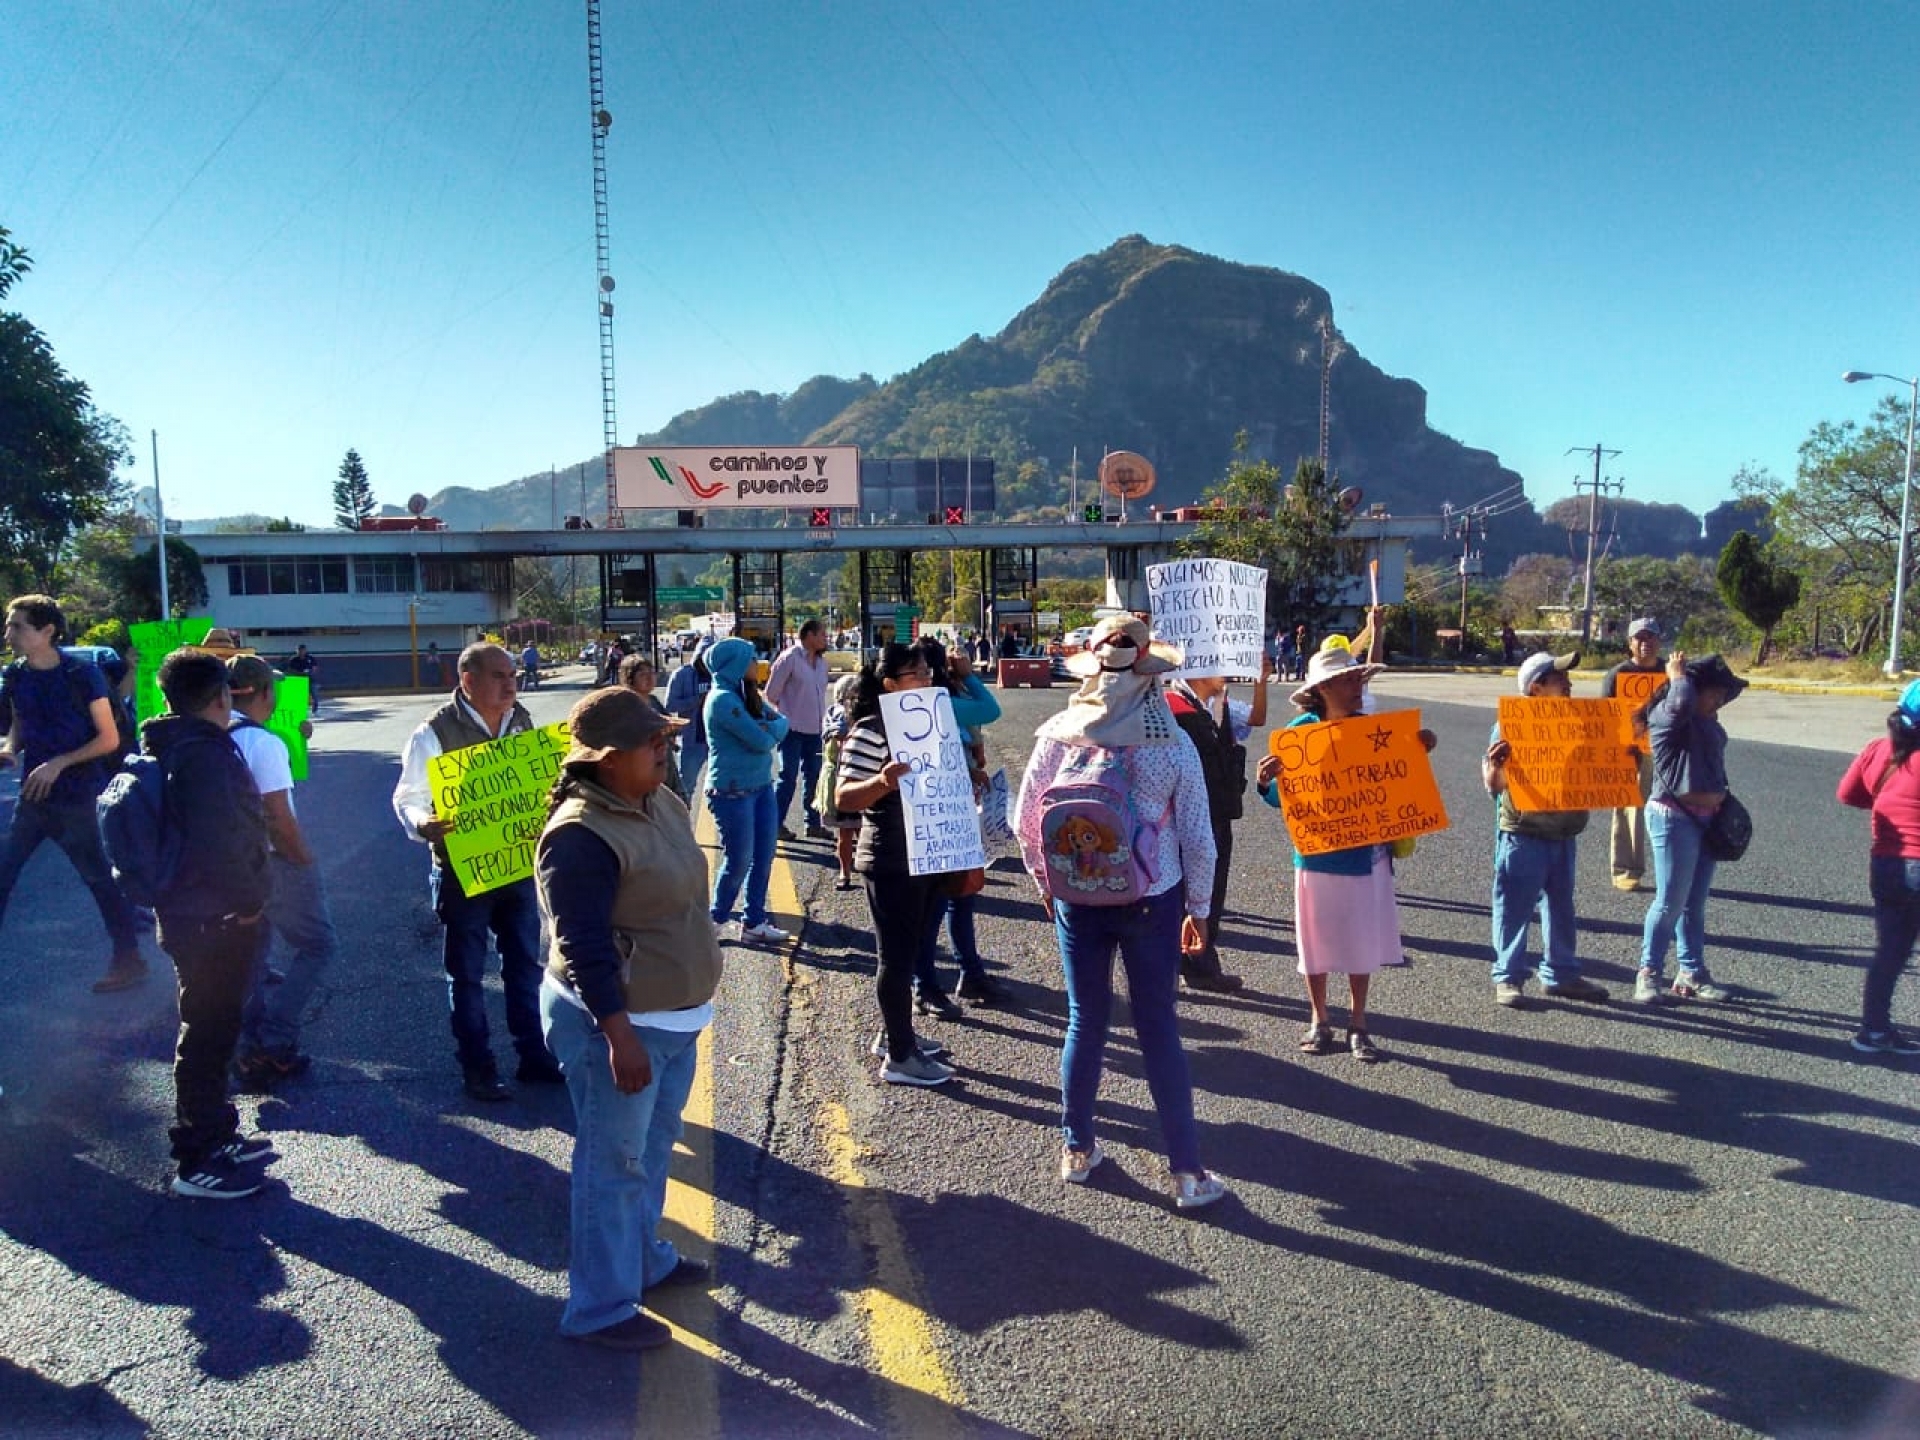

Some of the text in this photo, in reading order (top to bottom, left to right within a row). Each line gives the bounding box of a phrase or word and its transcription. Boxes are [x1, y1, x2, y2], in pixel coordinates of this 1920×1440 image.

[709, 452, 807, 472] caminos
[737, 474, 829, 500] puentes
[1149, 561, 1224, 590] EXIGIMOS
[1152, 585, 1224, 616] DERECHO
[1230, 587, 1240, 610] A
[1501, 700, 1622, 720] LOS VECINOS DE LA
[1532, 723, 1550, 742] DEL
[1557, 721, 1605, 742] CARMEN
[436, 734, 530, 781] EXIGIMOS
[536, 729, 552, 750] A
[1277, 721, 1345, 772] SCT
[1573, 746, 1597, 765] QUE
[1604, 747, 1618, 764] SE
[896, 751, 936, 775] POR
[442, 766, 522, 809] CONCLUYA
[904, 779, 916, 799] Y
[1282, 758, 1408, 796] RETOMA TRABAJO
[1568, 767, 1581, 786] EL
[1586, 767, 1638, 786] TRABAJO
[1287, 786, 1387, 822] ABANDONADO
[914, 822, 936, 841] EL
[1295, 812, 1371, 840] CARRETERA
[1376, 809, 1391, 825] DE
